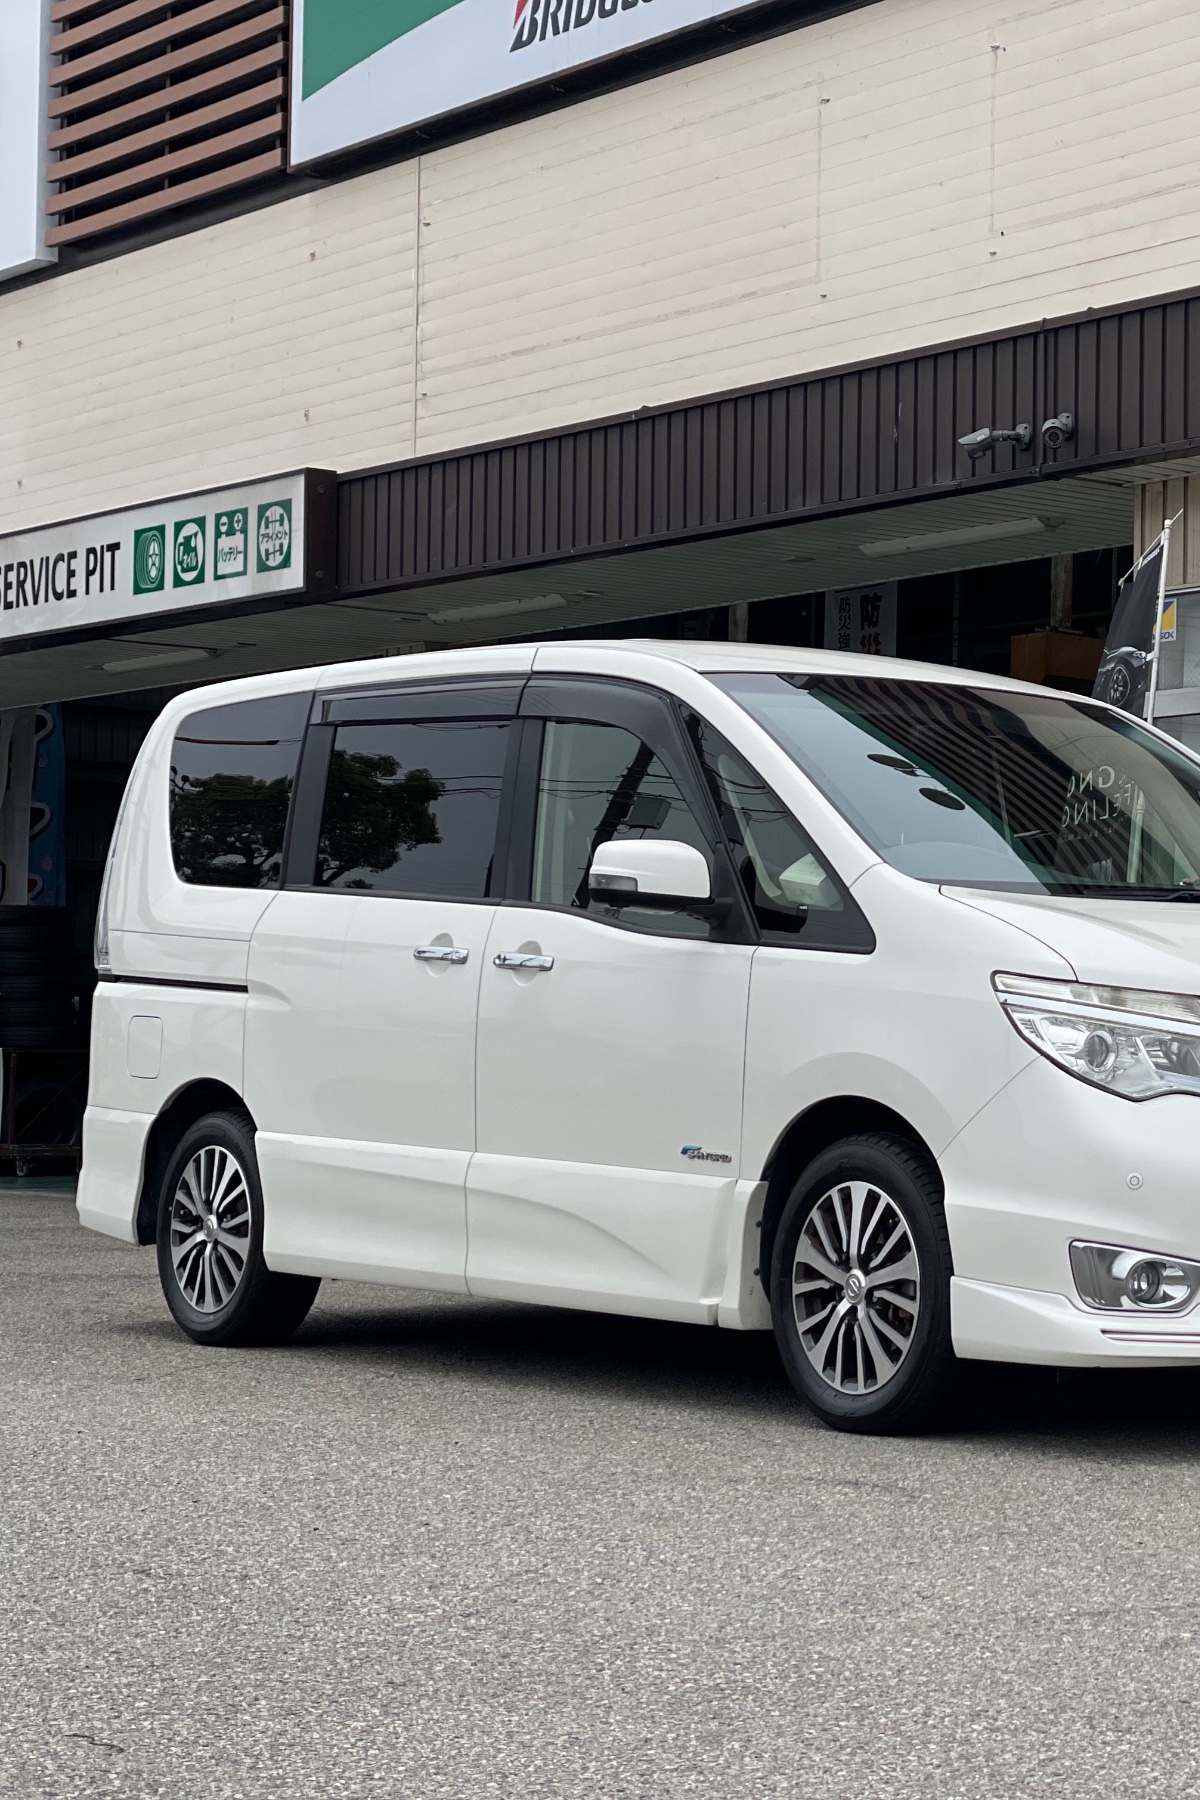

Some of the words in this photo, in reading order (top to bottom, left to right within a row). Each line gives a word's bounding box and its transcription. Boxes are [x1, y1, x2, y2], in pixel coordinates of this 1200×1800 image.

[260, 528, 288, 544] アライメント
[182, 551, 197, 568] オイル
[218, 546, 243, 563] バッテリー
[0, 550, 77, 611] ERVICE
[85, 541, 121, 595] PIT
